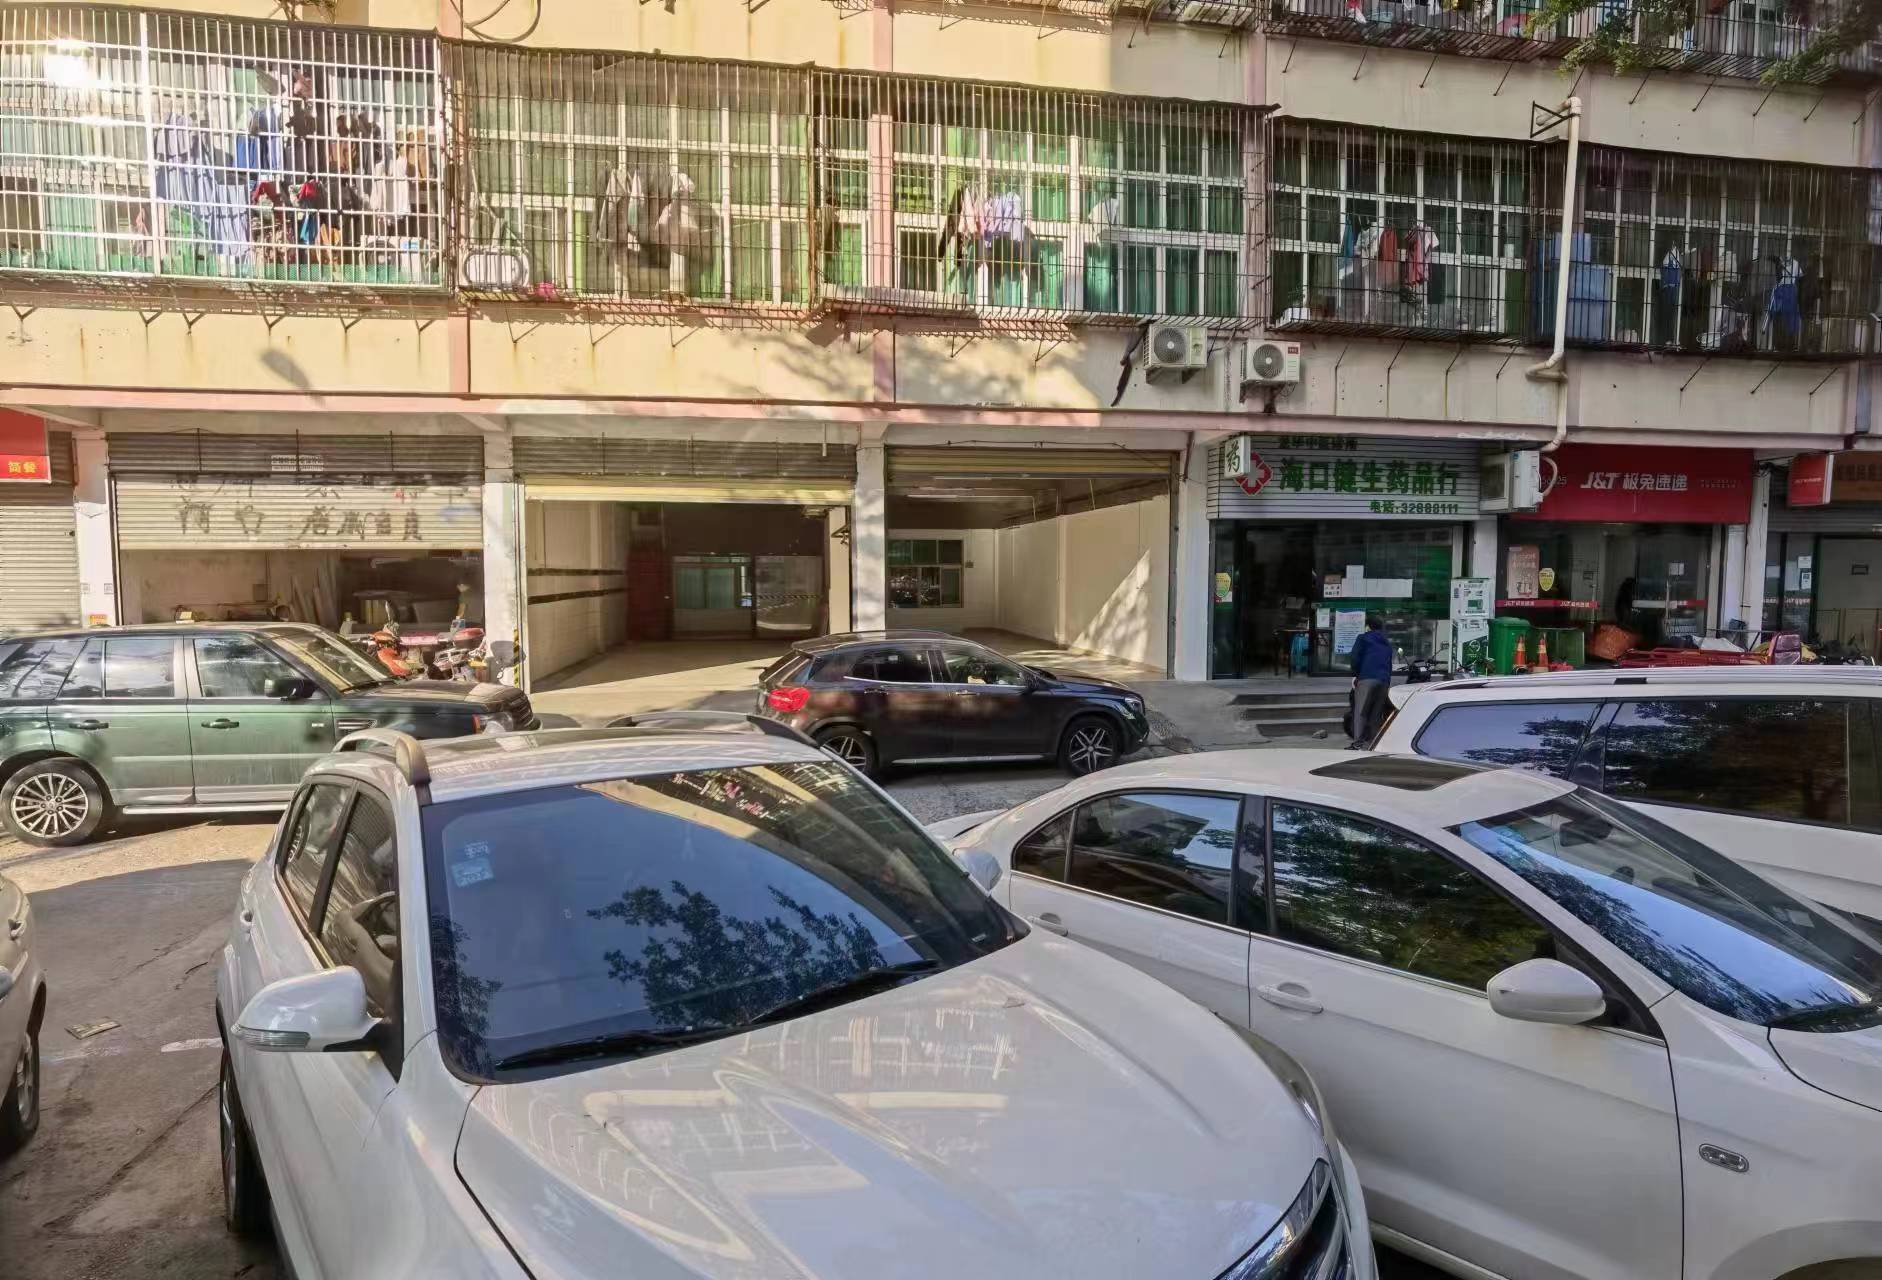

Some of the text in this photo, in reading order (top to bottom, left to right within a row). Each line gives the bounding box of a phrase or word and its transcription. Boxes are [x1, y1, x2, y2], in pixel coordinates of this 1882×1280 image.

[1226, 440, 1240, 472] 药
[1580, 472, 1621, 489] J&T
[1623, 472, 1688, 491] 极兔速递
